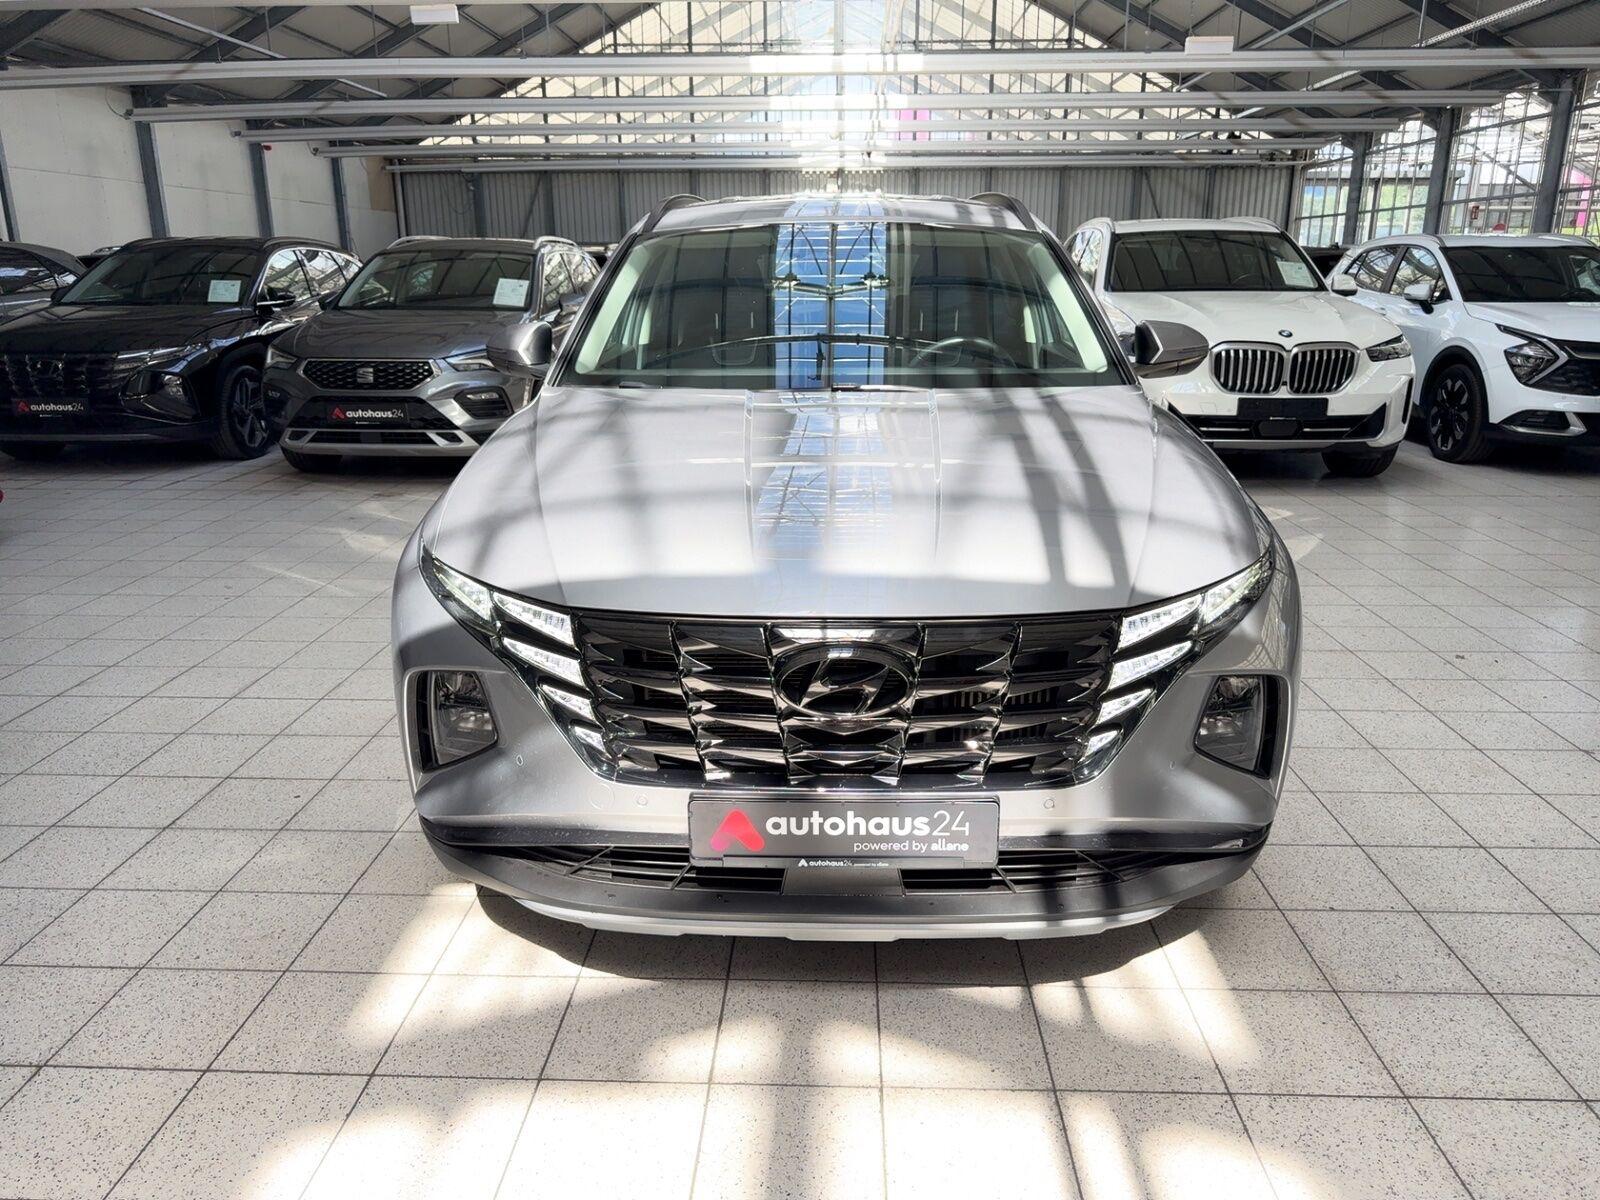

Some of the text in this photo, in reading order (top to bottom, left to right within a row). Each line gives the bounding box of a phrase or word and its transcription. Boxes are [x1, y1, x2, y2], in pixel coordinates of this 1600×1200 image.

[30, 403, 84, 411] autohaus24
[345, 409, 404, 418] autohaus24
[765, 810, 970, 836] autohaus24
[853, 838, 970, 853] powered by allane
[808, 859, 853, 867] autohaus24
